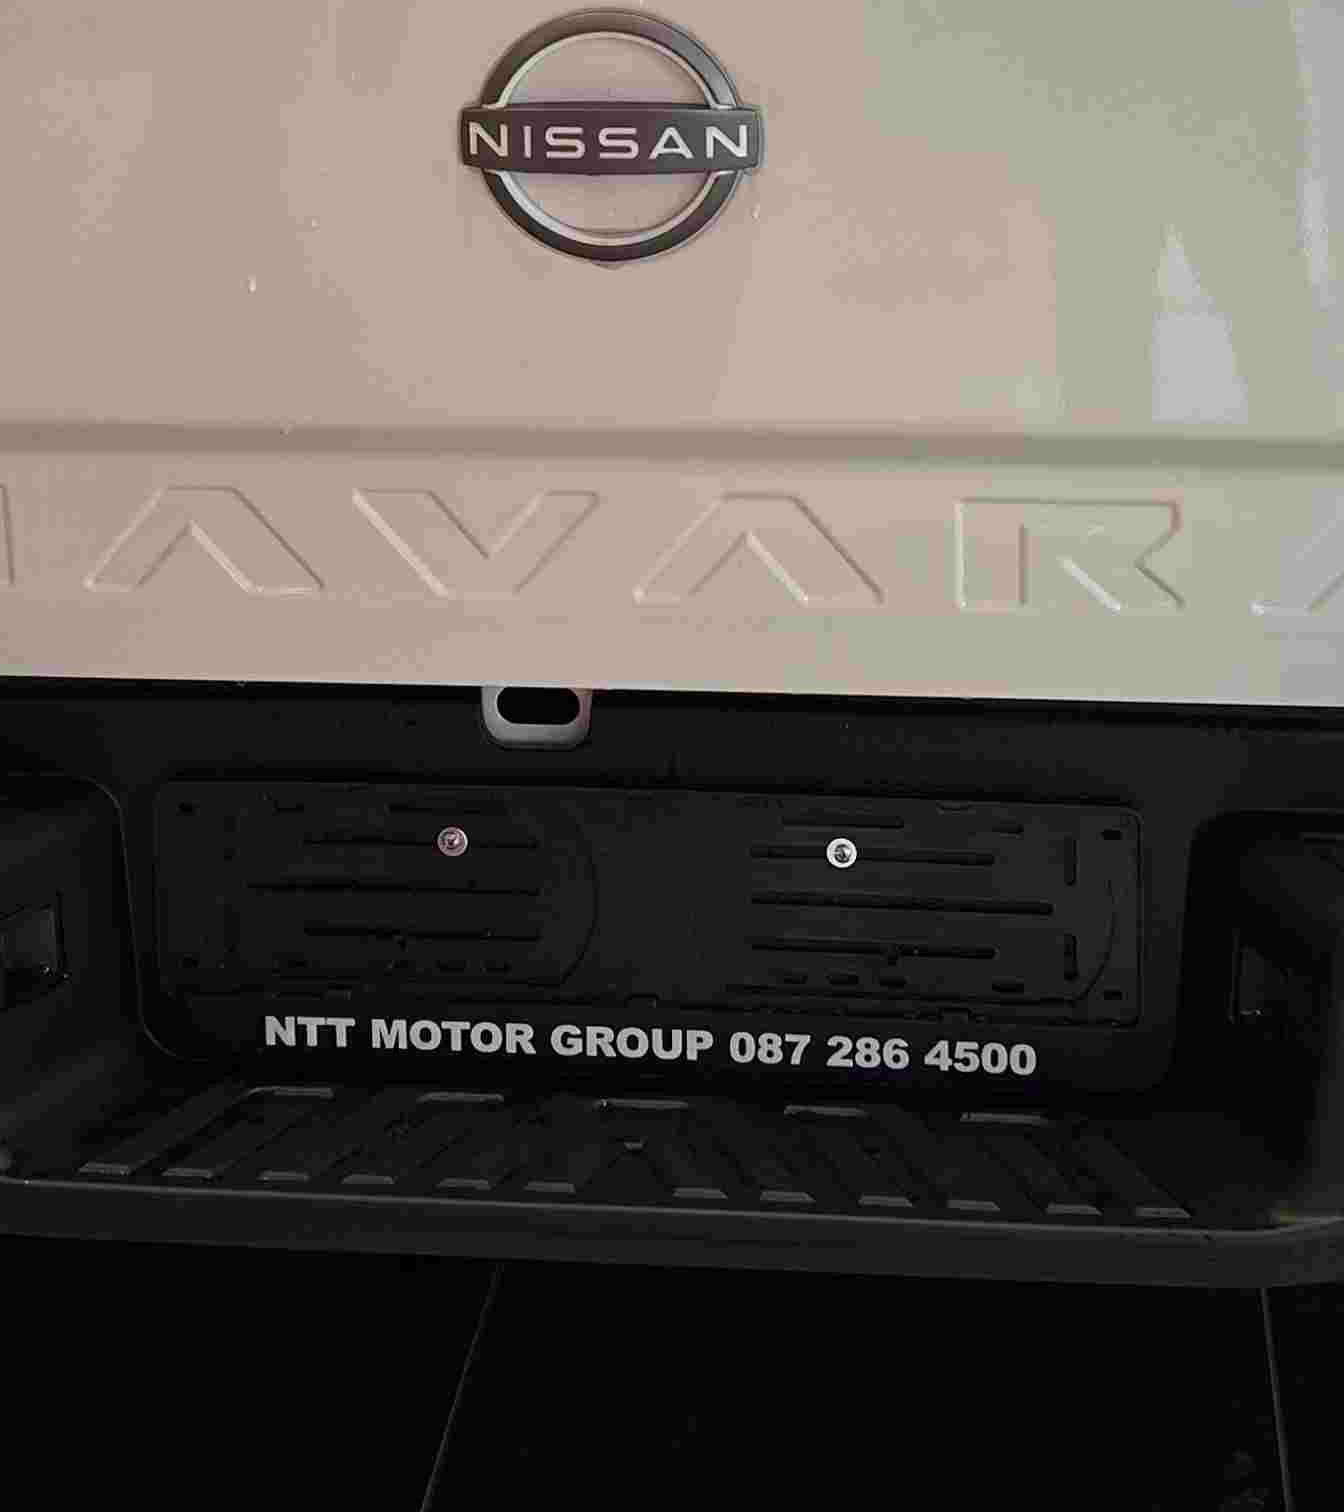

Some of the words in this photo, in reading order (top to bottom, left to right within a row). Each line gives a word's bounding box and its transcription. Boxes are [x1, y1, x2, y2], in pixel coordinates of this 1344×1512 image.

[468, 121, 749, 160] NISSAN
[264, 1015, 356, 1048] NTT
[371, 1018, 537, 1055] MOTOR
[550, 1024, 714, 1061] GROUP
[729, 1031, 811, 1065] 087
[826, 1035, 910, 1070] 286
[924, 1039, 1037, 1076] 4500
